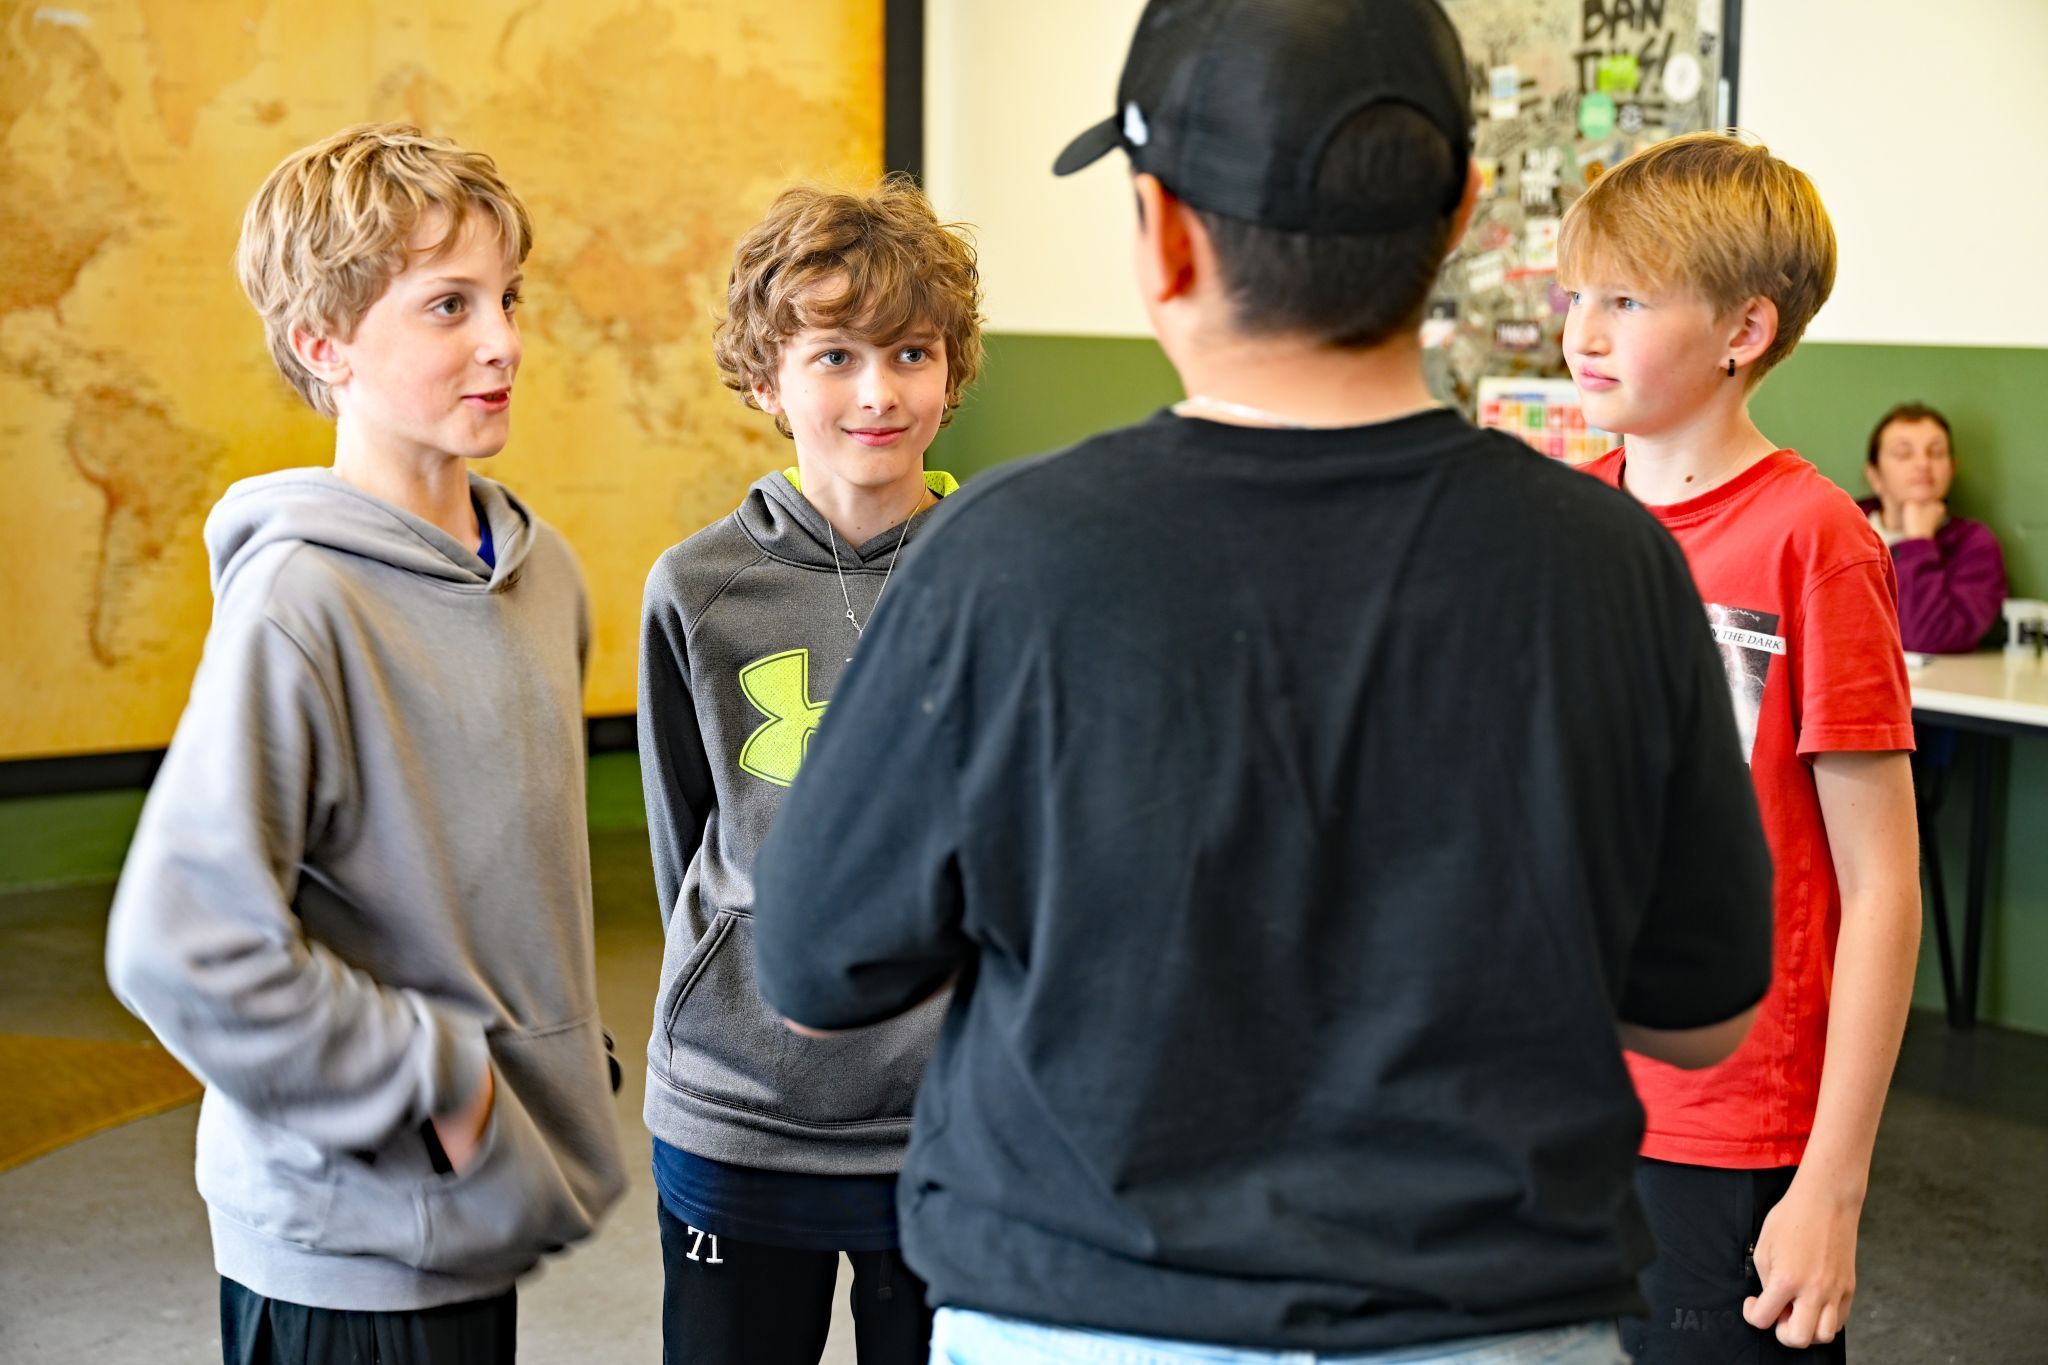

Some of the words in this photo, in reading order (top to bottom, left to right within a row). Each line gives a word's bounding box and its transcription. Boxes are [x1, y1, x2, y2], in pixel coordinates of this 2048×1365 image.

[1722, 629, 1745, 644] THE
[1747, 635, 1782, 651] DARK
[686, 1225, 724, 1264] 71
